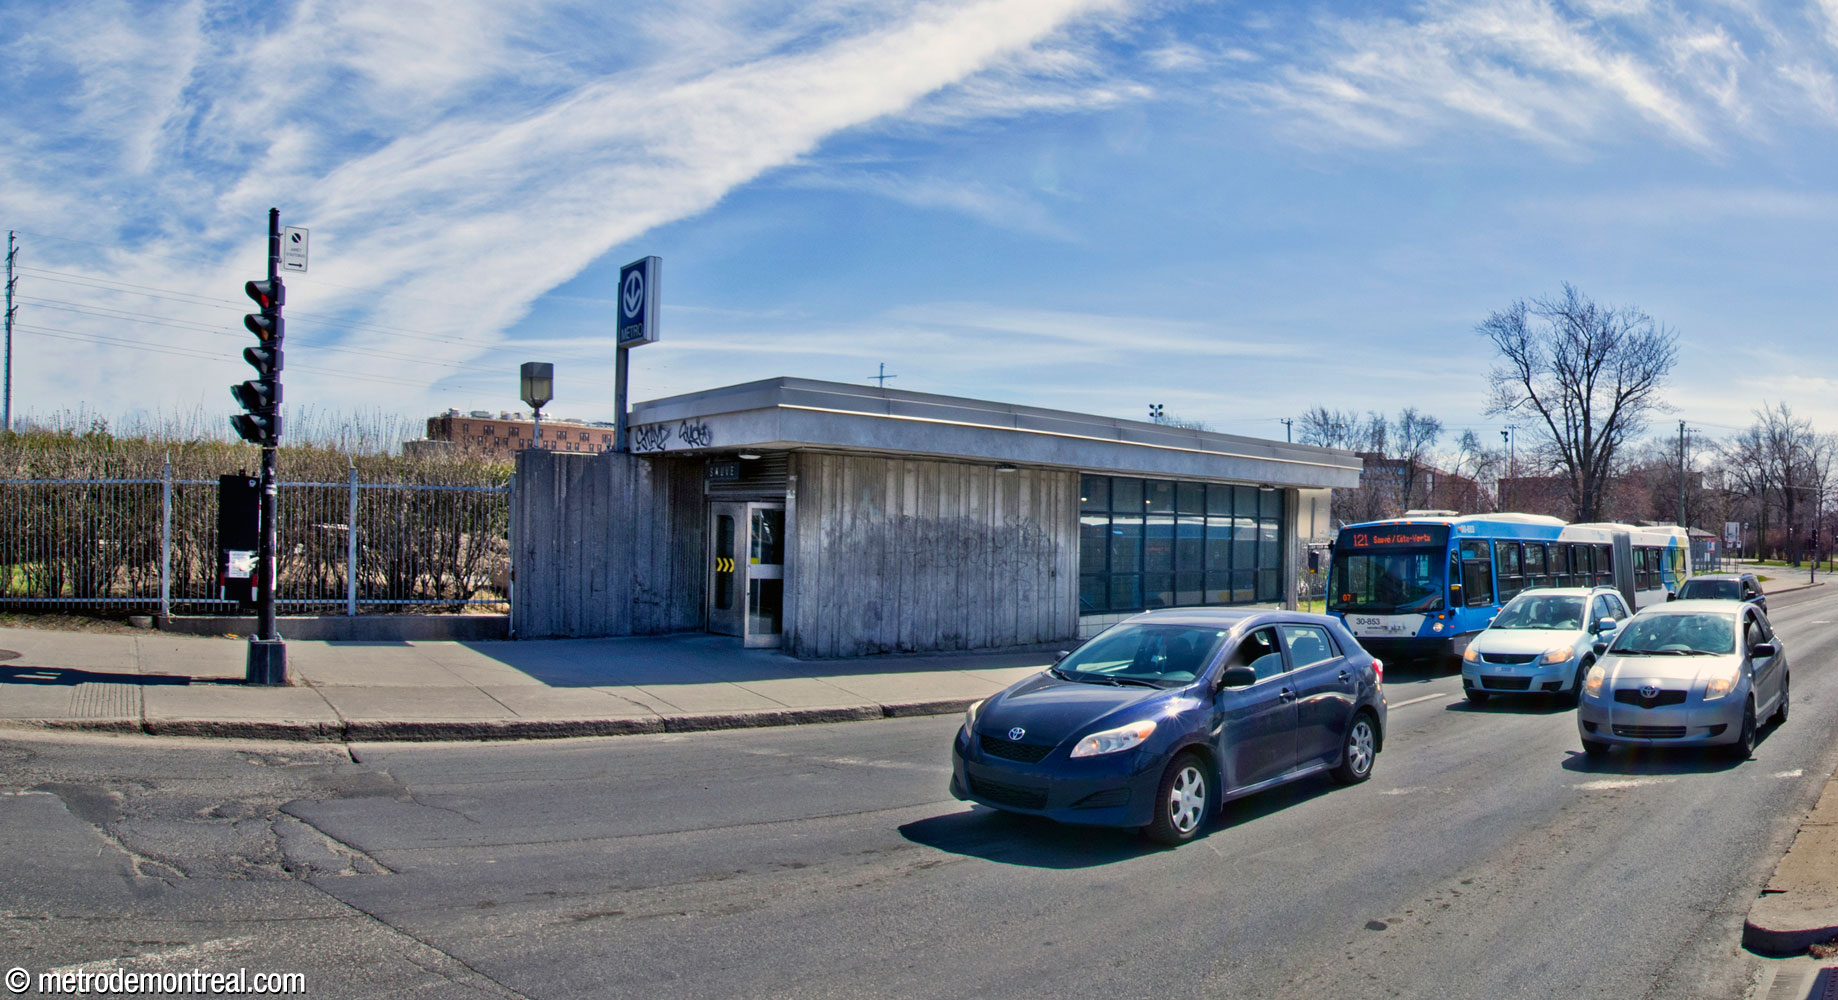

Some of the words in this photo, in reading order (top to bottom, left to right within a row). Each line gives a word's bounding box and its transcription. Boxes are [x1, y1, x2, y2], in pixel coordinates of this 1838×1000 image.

[621, 322, 642, 340] METRO
[1353, 534, 1369, 547] 121
[1342, 593, 1351, 602] 07
[1356, 618, 1380, 626] 30-853
